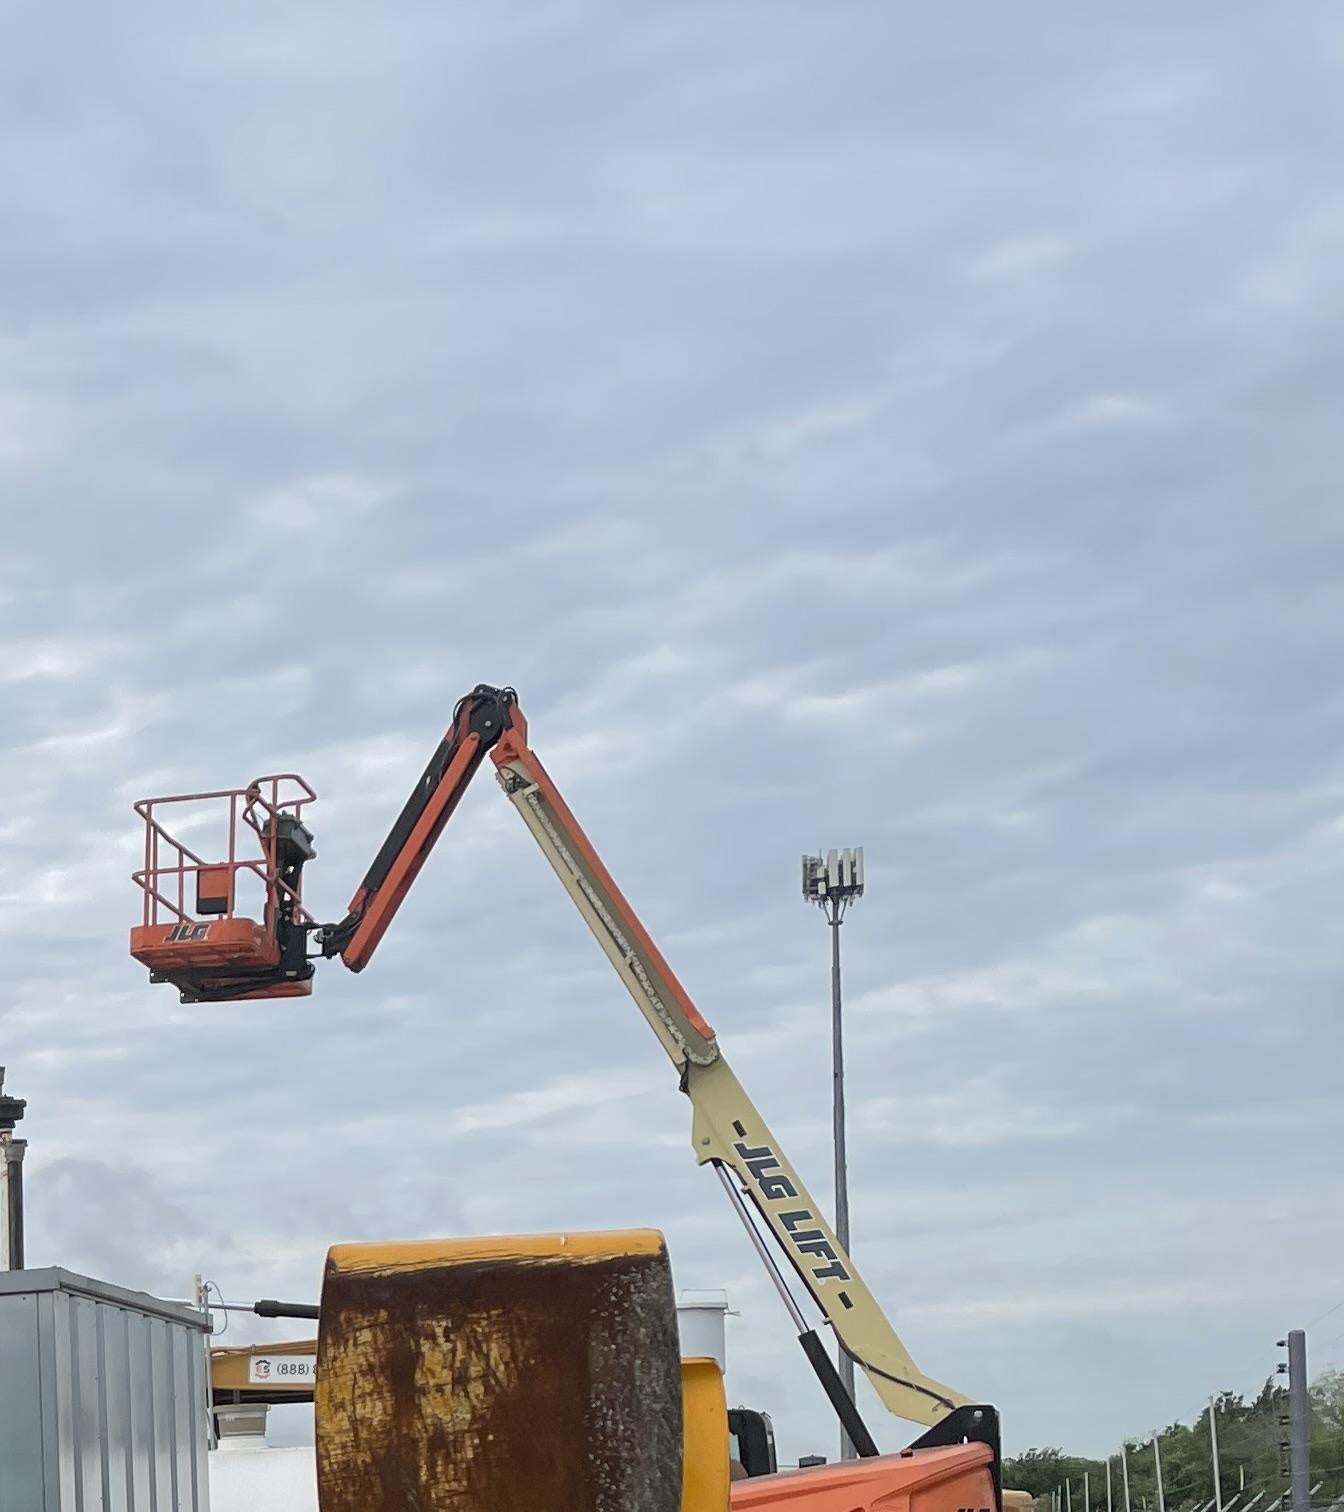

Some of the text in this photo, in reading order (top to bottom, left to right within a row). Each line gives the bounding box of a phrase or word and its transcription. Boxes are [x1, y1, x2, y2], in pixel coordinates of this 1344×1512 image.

[163, 923, 210, 943] JLG
[733, 1142, 851, 1283] JLG LIFT
[277, 1363, 310, 1375] (888)
